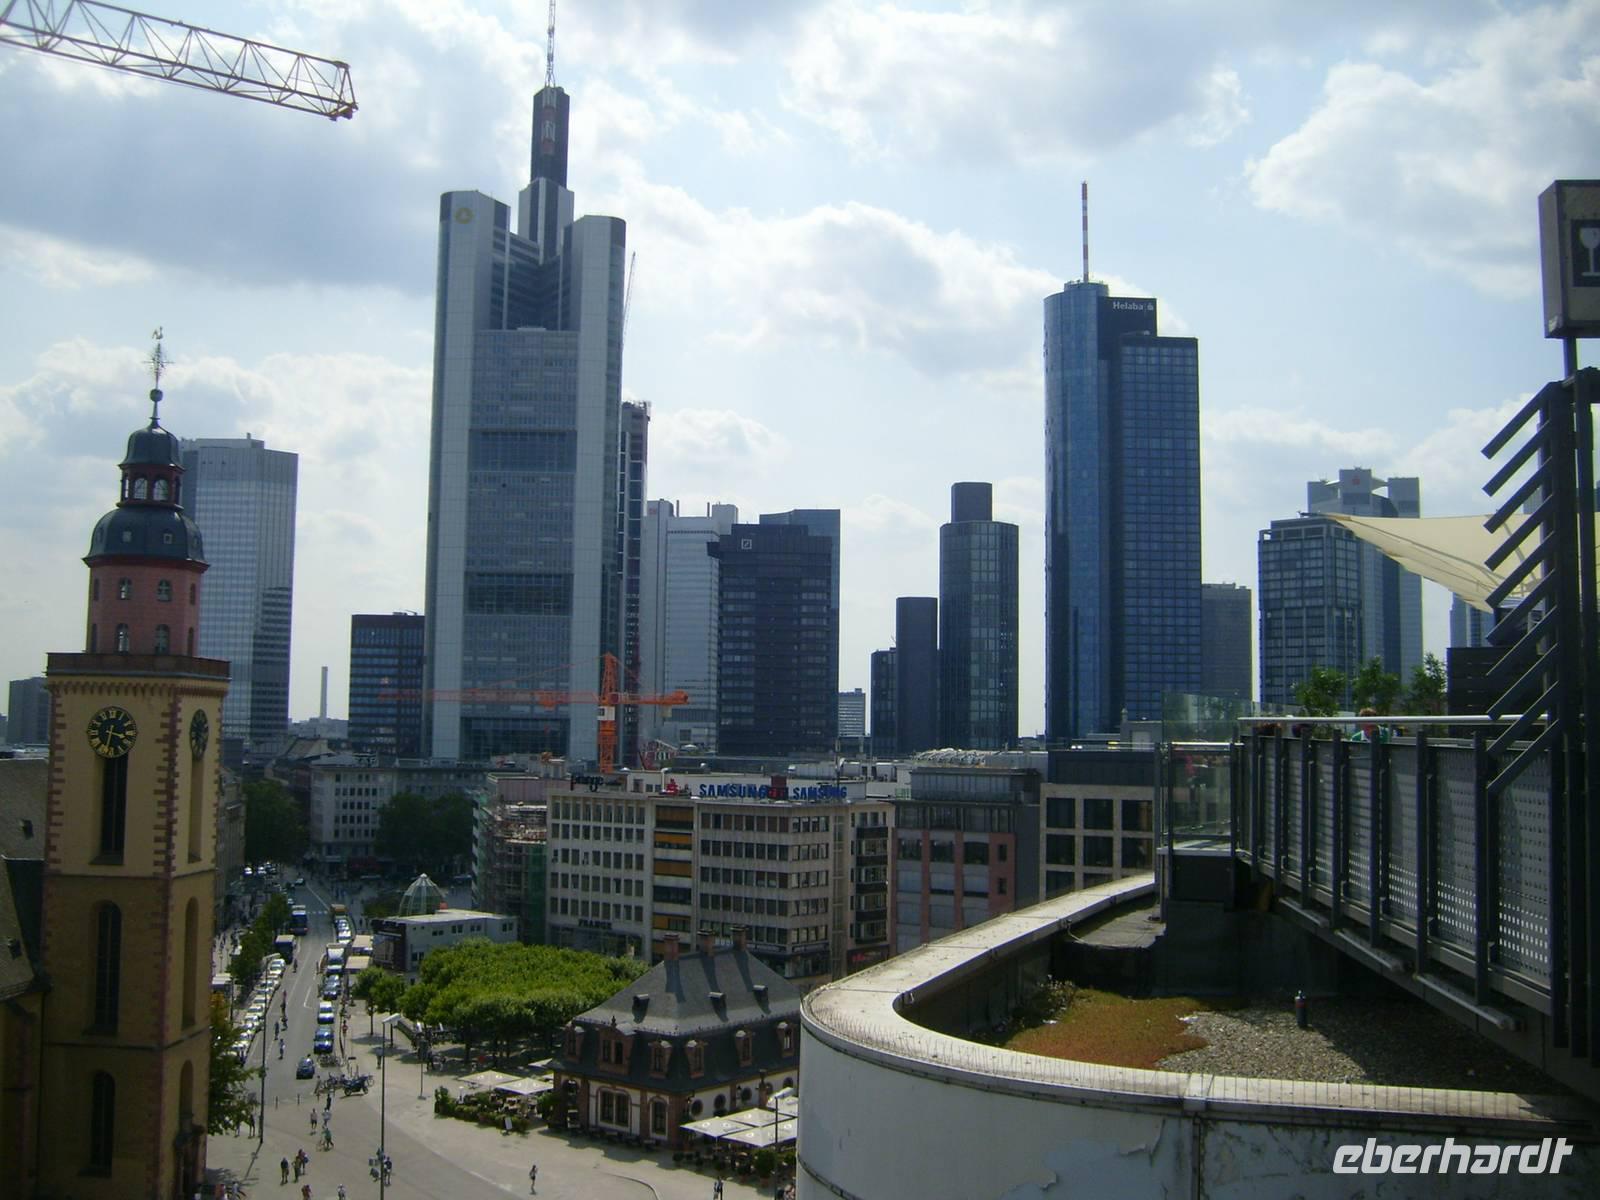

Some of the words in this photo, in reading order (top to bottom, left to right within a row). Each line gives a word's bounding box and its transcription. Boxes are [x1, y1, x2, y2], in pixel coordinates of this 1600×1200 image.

[1112, 301, 1144, 311] Helaba
[699, 783, 768, 799] SAMSUNG
[793, 786, 847, 800] SAMSUNG
